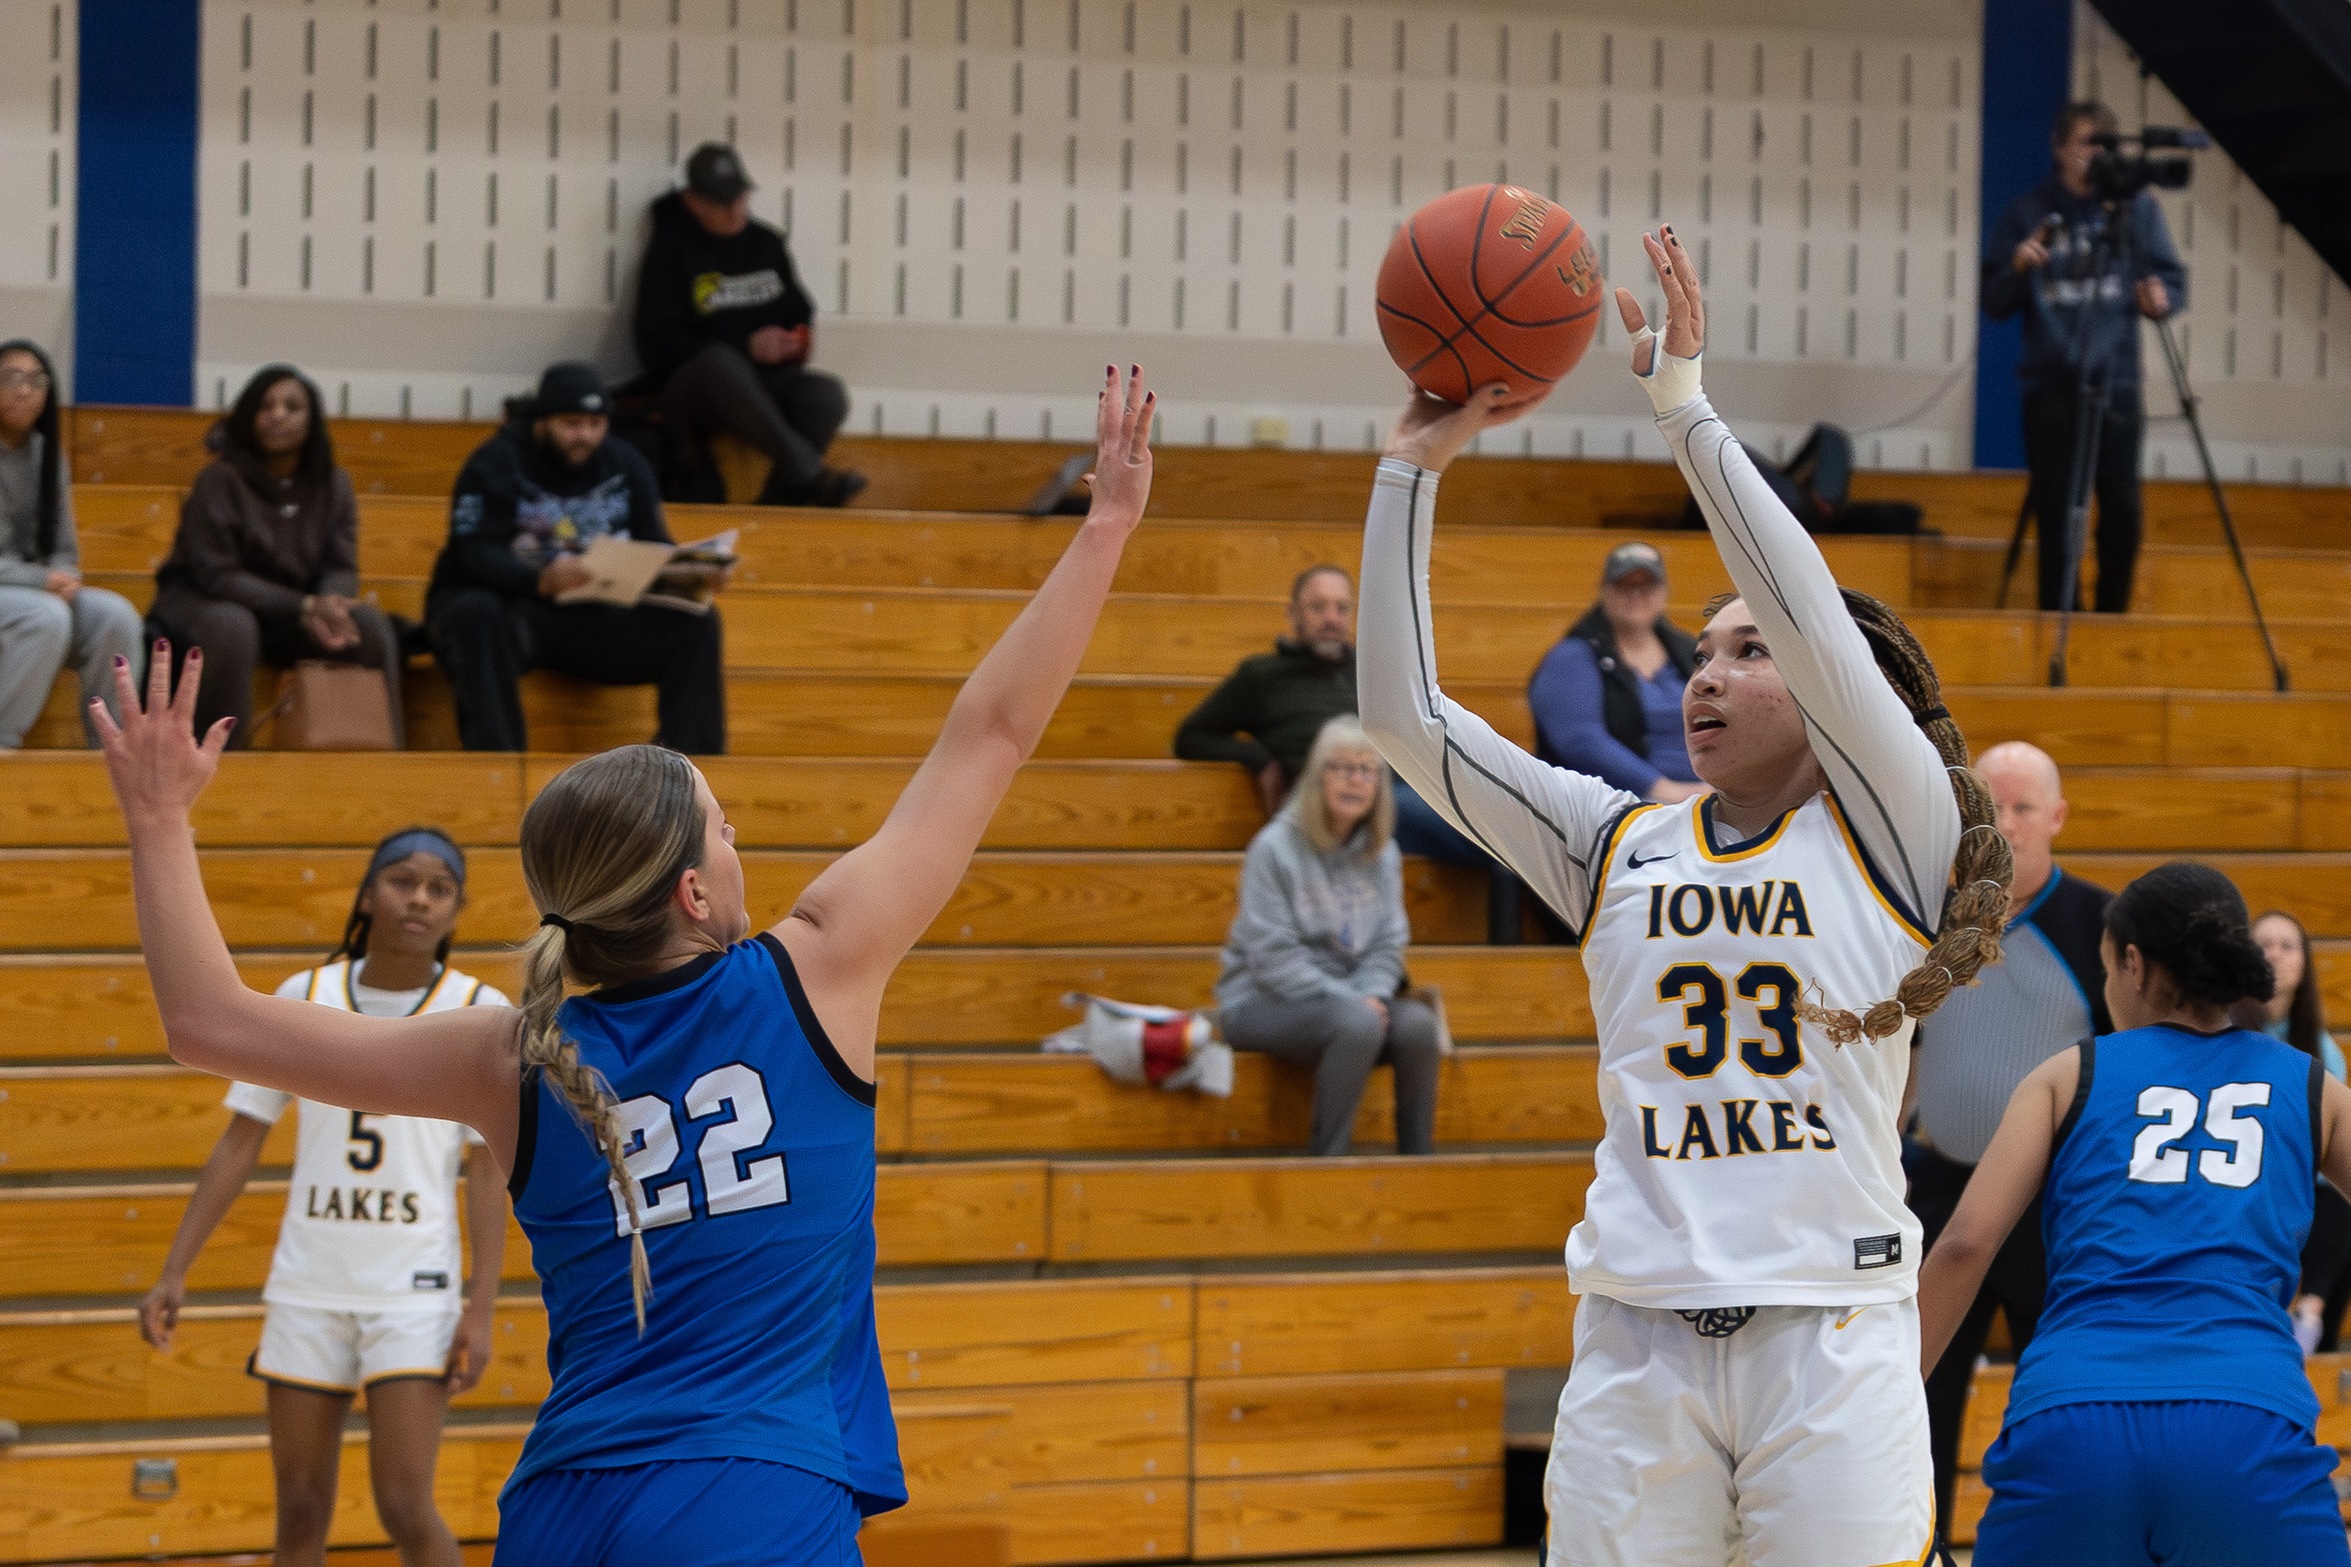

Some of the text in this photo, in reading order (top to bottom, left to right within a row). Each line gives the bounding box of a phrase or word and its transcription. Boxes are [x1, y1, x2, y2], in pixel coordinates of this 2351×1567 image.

[1646, 879, 1816, 940] IOWA
[1656, 961, 1804, 1081] 33
[347, 1109, 387, 1174] 5
[597, 1060, 792, 1238] 22
[1639, 1098, 1837, 1160] LAKES
[2127, 1081, 2272, 1190] 25
[306, 1185, 420, 1224] LAKES
